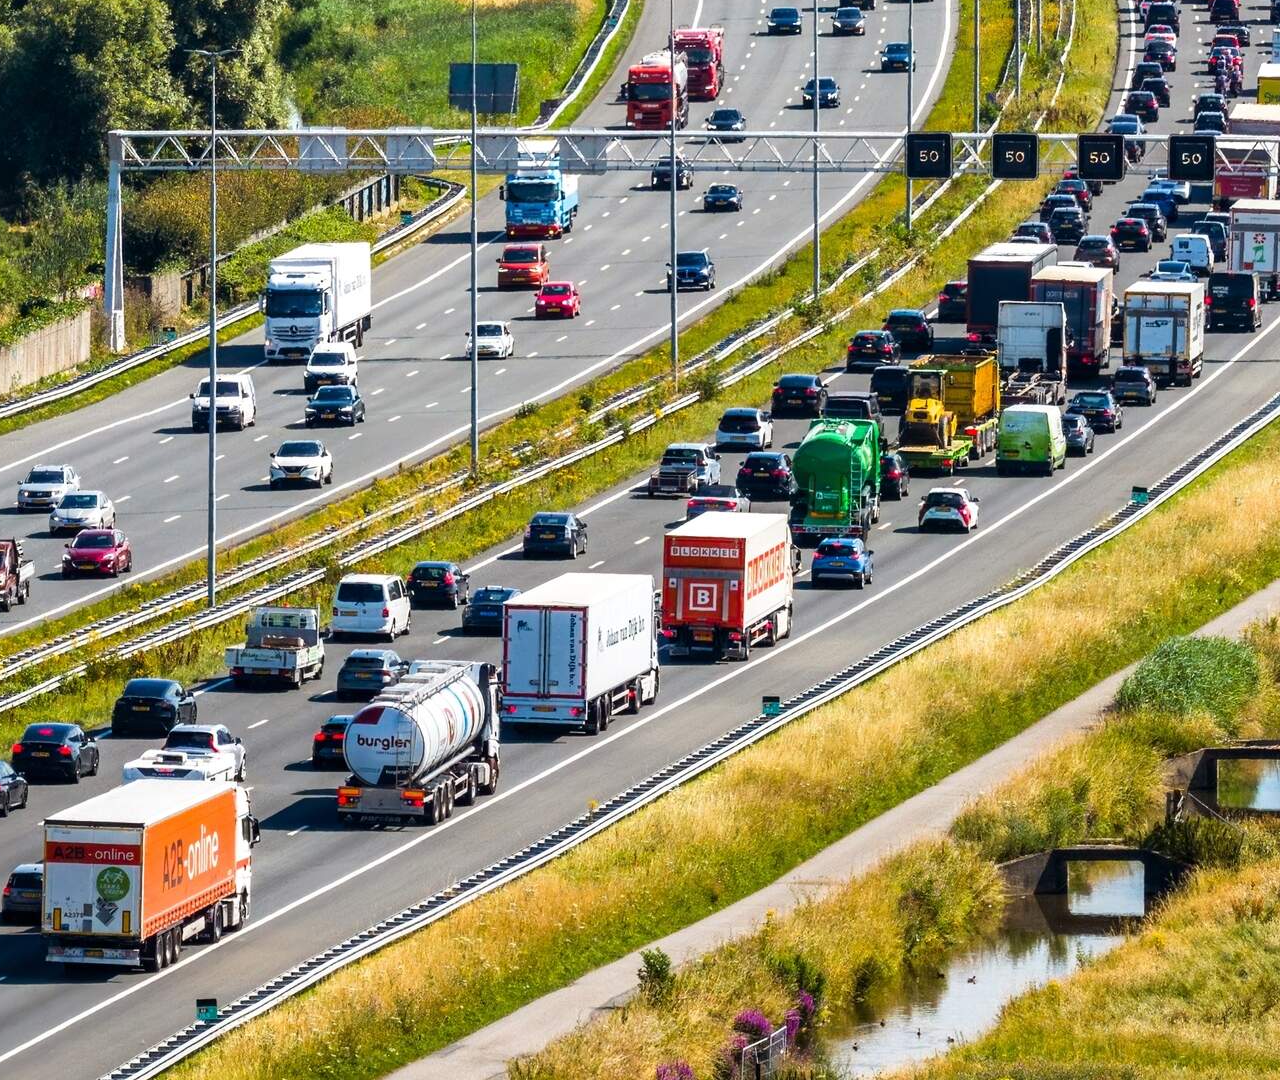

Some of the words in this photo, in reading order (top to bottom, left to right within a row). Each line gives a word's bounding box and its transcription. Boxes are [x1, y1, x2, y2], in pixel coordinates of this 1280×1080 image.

[919, 150, 939, 162] 50
[1005, 151, 1025, 163] 50
[1089, 152, 1110, 164] 50
[1181, 153, 1202, 165] 50
[671, 547, 739, 558] BLOKKER
[569, 613, 577, 638] Johan
[568, 655, 577, 672] Dijk
[357, 734, 412, 751] burgler
[54, 846, 85, 858] A2B
[94, 848, 135, 861] online
